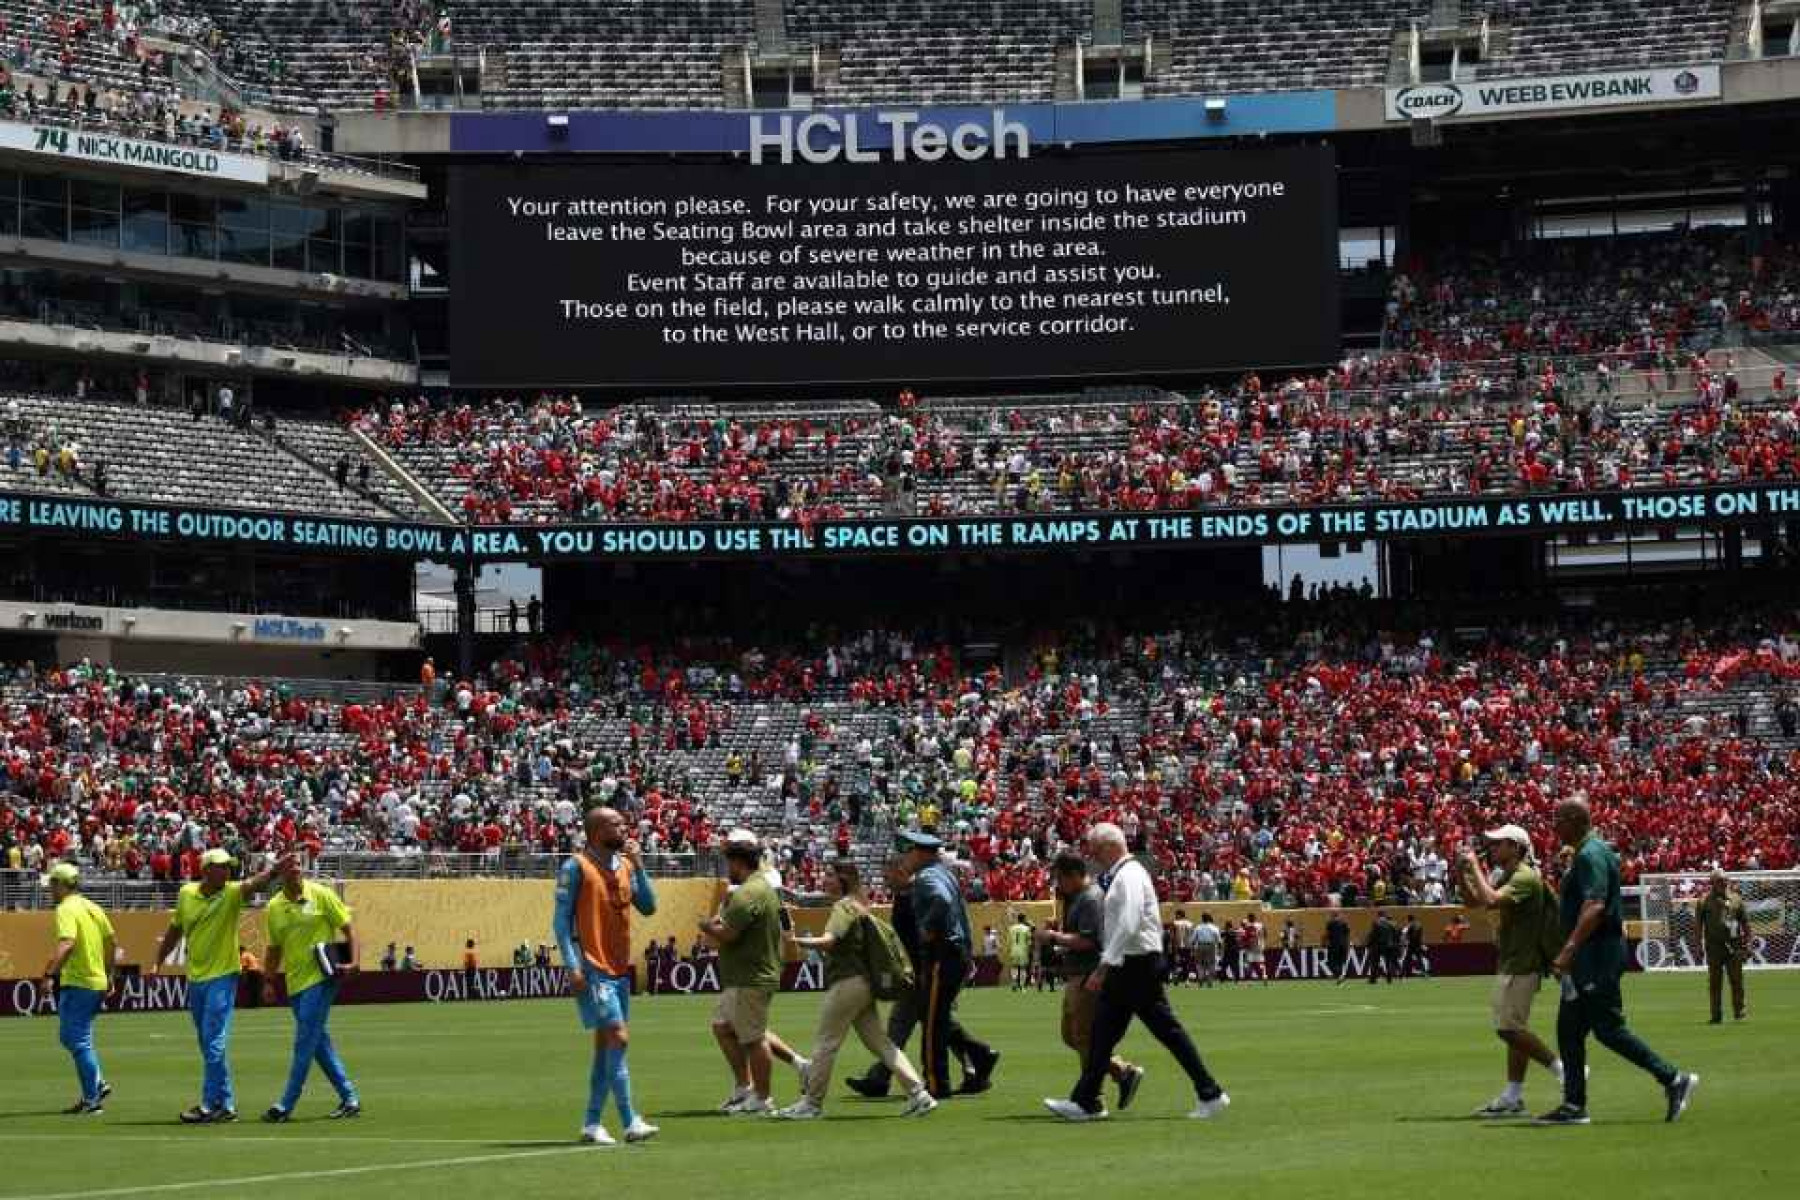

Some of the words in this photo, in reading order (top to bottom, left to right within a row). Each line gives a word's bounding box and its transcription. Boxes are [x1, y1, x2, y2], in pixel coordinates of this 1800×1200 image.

[1403, 94, 1455, 108] COACH
[1480, 84, 1548, 106] WEEB
[1552, 76, 1652, 100] EWBANK
[32, 127, 69, 153] 74
[78, 136, 120, 159] NICK
[124, 143, 219, 172] MANGOLD
[749, 109, 1029, 165] HCLTech
[508, 198, 560, 215] Your
[568, 197, 666, 215] attention
[675, 197, 750, 218] please.
[767, 195, 801, 212] For
[809, 197, 857, 214] your
[867, 192, 937, 211] safety,
[945, 195, 975, 208] we
[984, 195, 1016, 208] are
[1025, 189, 1088, 209] going
[1097, 189, 1118, 204] to
[1127, 184, 1176, 202] have
[1185, 182, 1284, 202] everyone
[548, 223, 602, 240] leave
[611, 221, 645, 240] the
[654, 222, 733, 243] Seating
[743, 219, 793, 238] Bowl
[801, 225, 847, 238] area
[855, 217, 895, 236] and
[904, 213, 951, 235] take
[958, 215, 1033, 234] shelter
[1042, 212, 1105, 231] inside
[1114, 210, 1148, 229] the
[1157, 208, 1245, 227] stadium
[682, 247, 771, 265] because
[780, 245, 802, 264] of
[810, 249, 878, 263] severe
[887, 242, 975, 261] weather
[983, 242, 1001, 259] in
[1010, 240, 1044, 257] the
[1054, 242, 1104, 257] area.
[628, 274, 686, 291] Event
[694, 272, 745, 291] Staff
[752, 276, 785, 290] are
[793, 270, 888, 289] available
[898, 272, 919, 287] to
[926, 266, 988, 291] guide
[996, 265, 1035, 283] and
[1046, 265, 1106, 282] assist
[1114, 266, 1160, 284] you.
[560, 300, 626, 318] Those
[636, 304, 662, 317] on
[672, 298, 705, 317] the
[714, 298, 768, 317] field,
[778, 296, 847, 318] please
[855, 295, 904, 313] walk
[913, 290, 984, 314] calmly
[991, 295, 1012, 310] to
[1020, 291, 1055, 309] the
[1063, 291, 1144, 307] nearest
[1153, 283, 1228, 304] tunnel,
[662, 328, 685, 343] to
[693, 324, 727, 342] the
[735, 325, 789, 341] West
[797, 322, 844, 342] Hall,
[853, 326, 876, 340] or
[883, 323, 904, 338] to
[913, 319, 947, 337] the
[956, 322, 1030, 336] service
[1040, 315, 1133, 334] corridor.
[30, 501, 122, 530] LEAVING
[131, 509, 170, 533] THE
[178, 513, 285, 541] OUTDOOR
[293, 521, 378, 548] SEATING
[386, 528, 445, 552] BOWL
[538, 531, 593, 552] YOU
[603, 530, 706, 552] SHOULD
[715, 528, 761, 551] USE
[824, 526, 899, 548] SPACE
[908, 524, 949, 546] ON
[958, 523, 1002, 545] THE
[1012, 521, 1100, 543] RAMPS
[1110, 519, 1139, 541] AT
[1147, 517, 1192, 540] THE
[1202, 514, 1269, 538] ENDS
[1277, 512, 1312, 535] OF
[1320, 511, 1366, 533] THE
[1376, 505, 1488, 532] STADIUM
[1497, 504, 1531, 526] AS
[1539, 500, 1613, 524] WELL.
[1622, 494, 1706, 520] THOSE
[1715, 492, 1757, 515] ON
[119, 975, 188, 1010] AIRW
[510, 967, 572, 997] AIRWA
